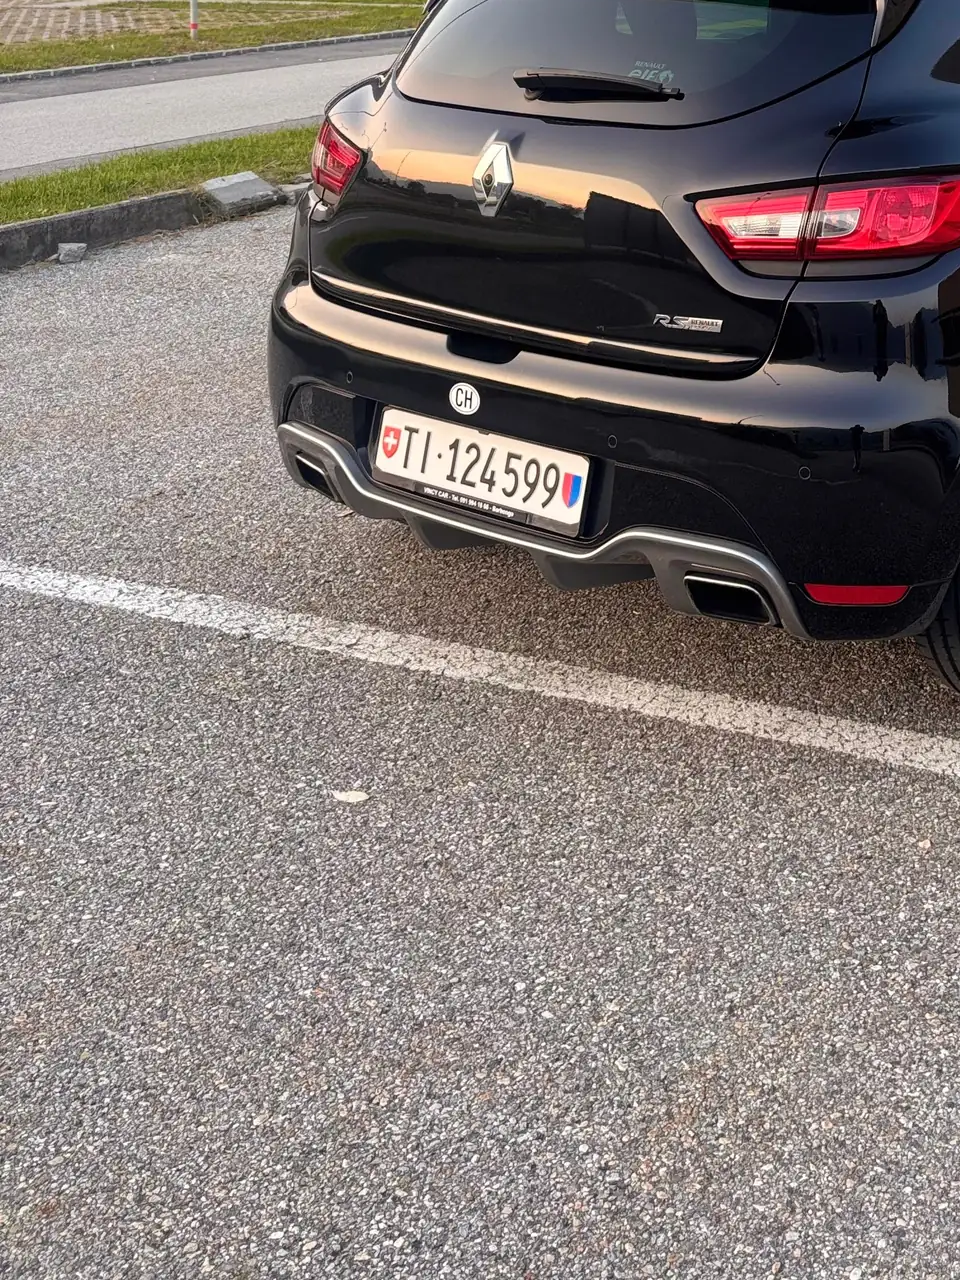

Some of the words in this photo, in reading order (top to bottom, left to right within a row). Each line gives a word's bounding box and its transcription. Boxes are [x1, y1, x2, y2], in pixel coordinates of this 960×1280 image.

[634, 60, 667, 69] RENAULT
[455, 387, 474, 410] CH
[438, 490, 449, 499] CAR
